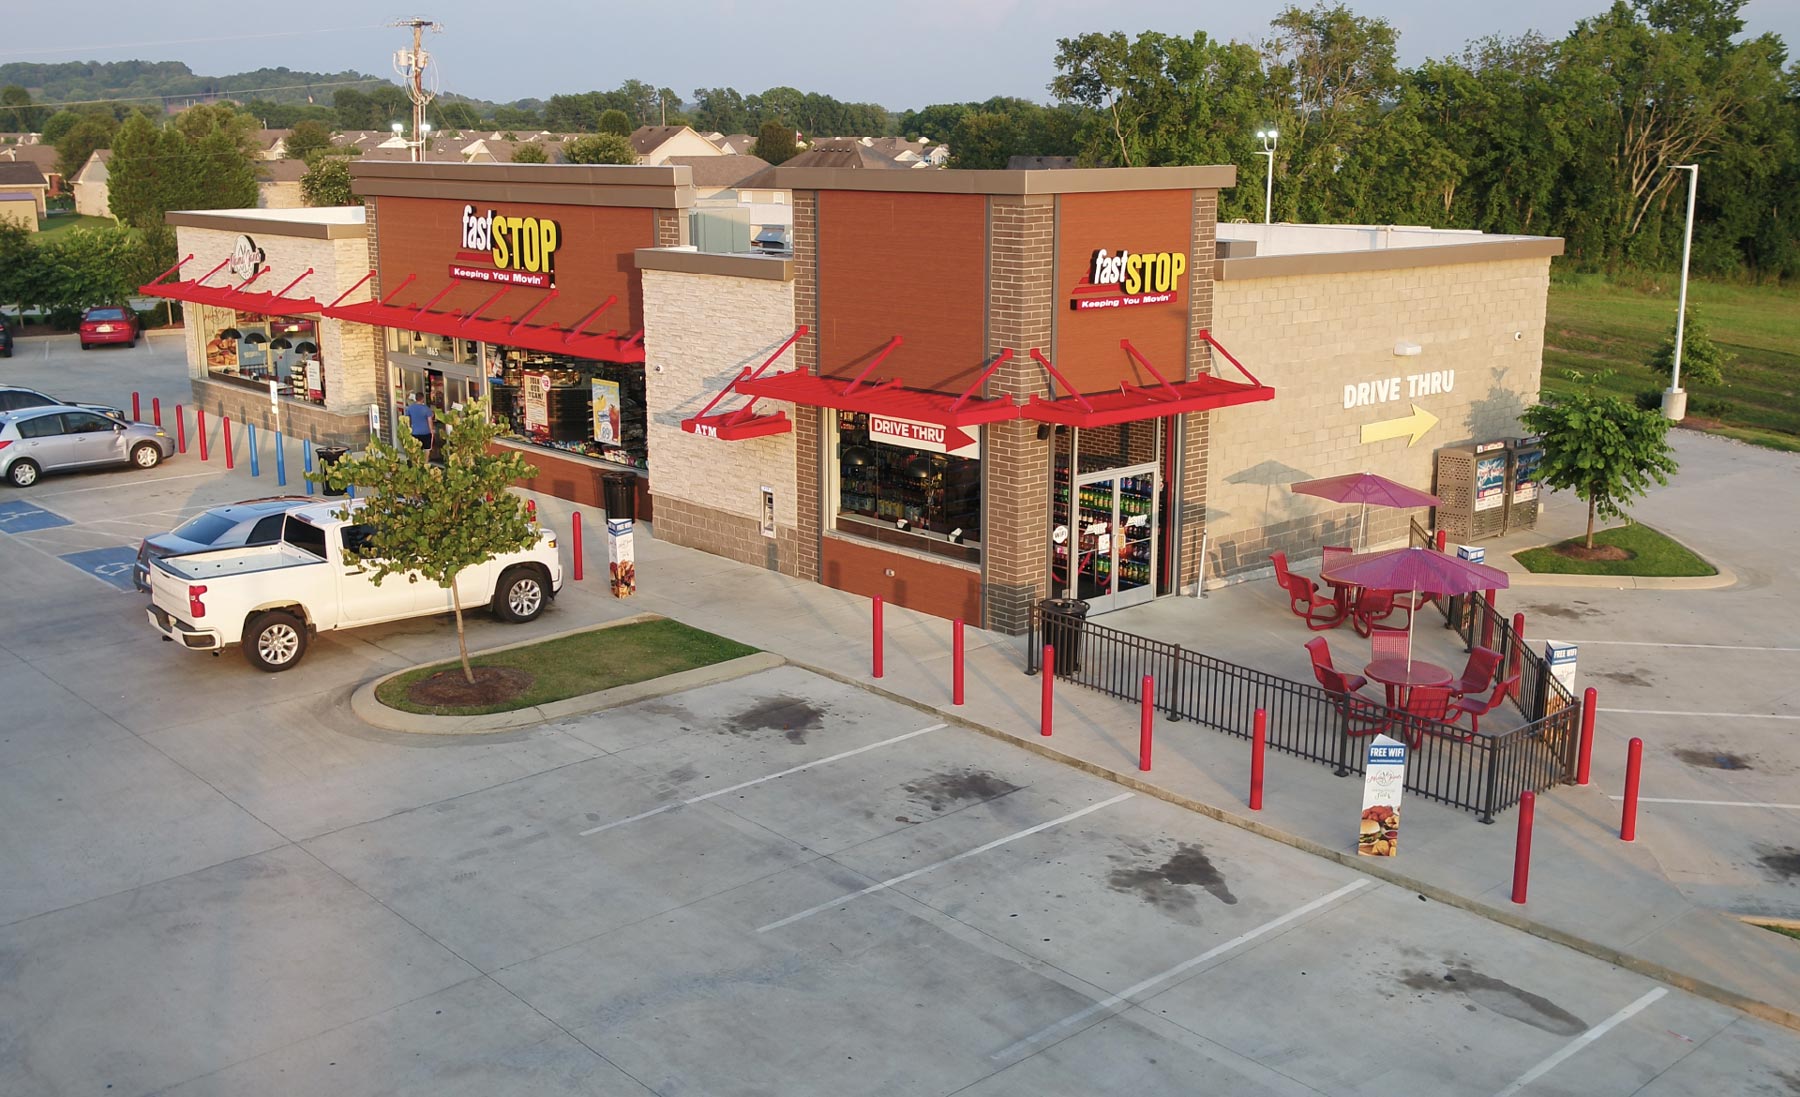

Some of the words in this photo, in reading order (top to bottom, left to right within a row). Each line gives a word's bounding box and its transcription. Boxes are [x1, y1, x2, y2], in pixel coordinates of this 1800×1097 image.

[454, 268, 490, 280] Keeping
[492, 271, 510, 281] You
[513, 273, 543, 285] Movin'
[1081, 299, 1120, 309] Keeping
[1123, 297, 1140, 306] You
[1143, 294, 1172, 304] Movin'
[1343, 377, 1402, 409] DRIVE
[1406, 369, 1455, 399] THRU
[695, 423, 718, 438] ATM
[874, 418, 910, 437] DRIVE
[912, 425, 945, 443] THRU
[1370, 747, 1388, 758] FREE
[1388, 747, 1405, 758] WIFI
